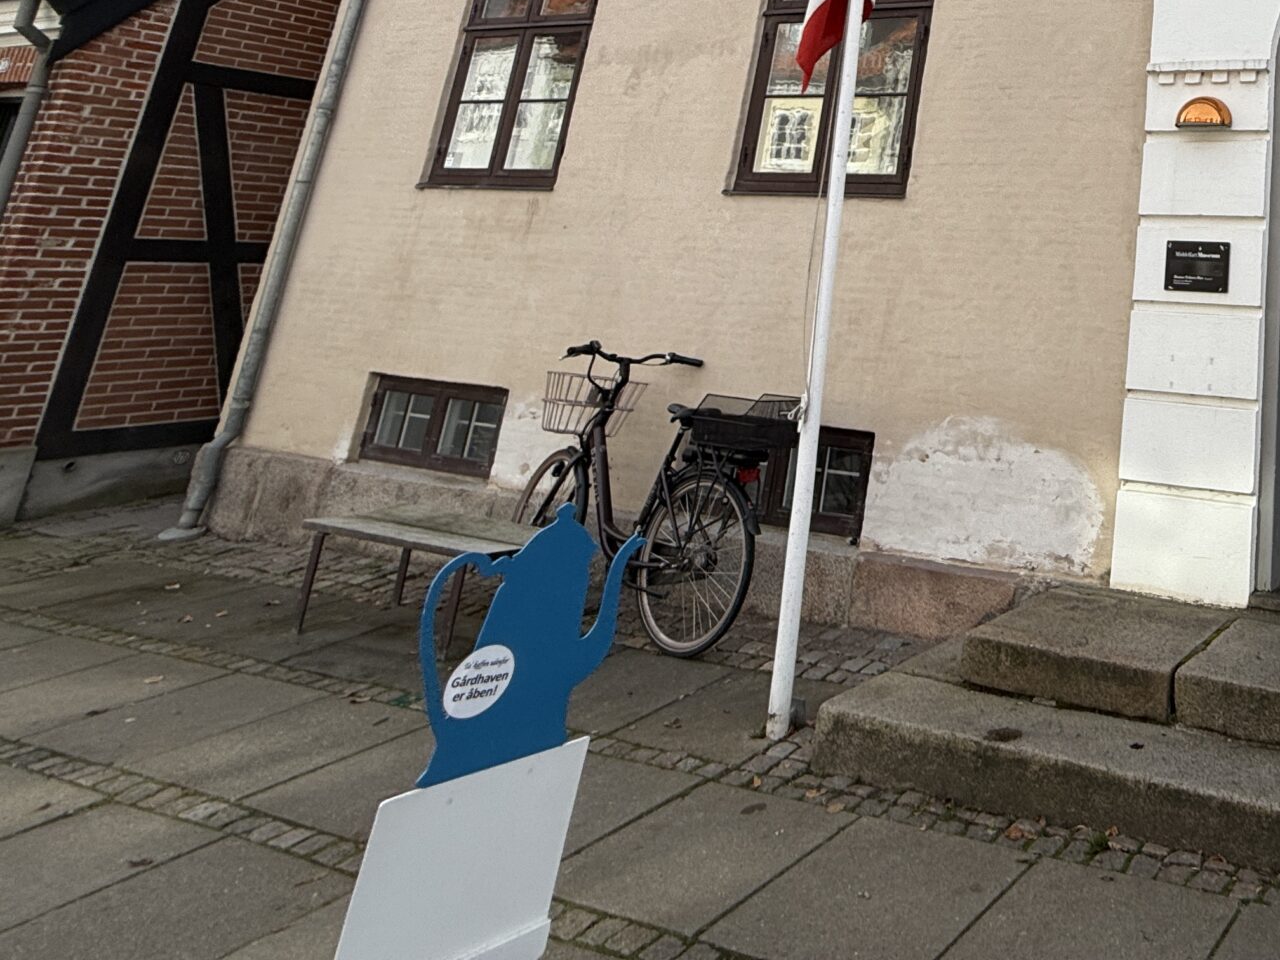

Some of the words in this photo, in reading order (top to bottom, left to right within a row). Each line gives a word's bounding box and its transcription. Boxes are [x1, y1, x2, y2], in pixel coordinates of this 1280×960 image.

[451, 672, 510, 688] Gårdhaven
[452, 692, 466, 702] er
[465, 684, 499, 700] åben!
